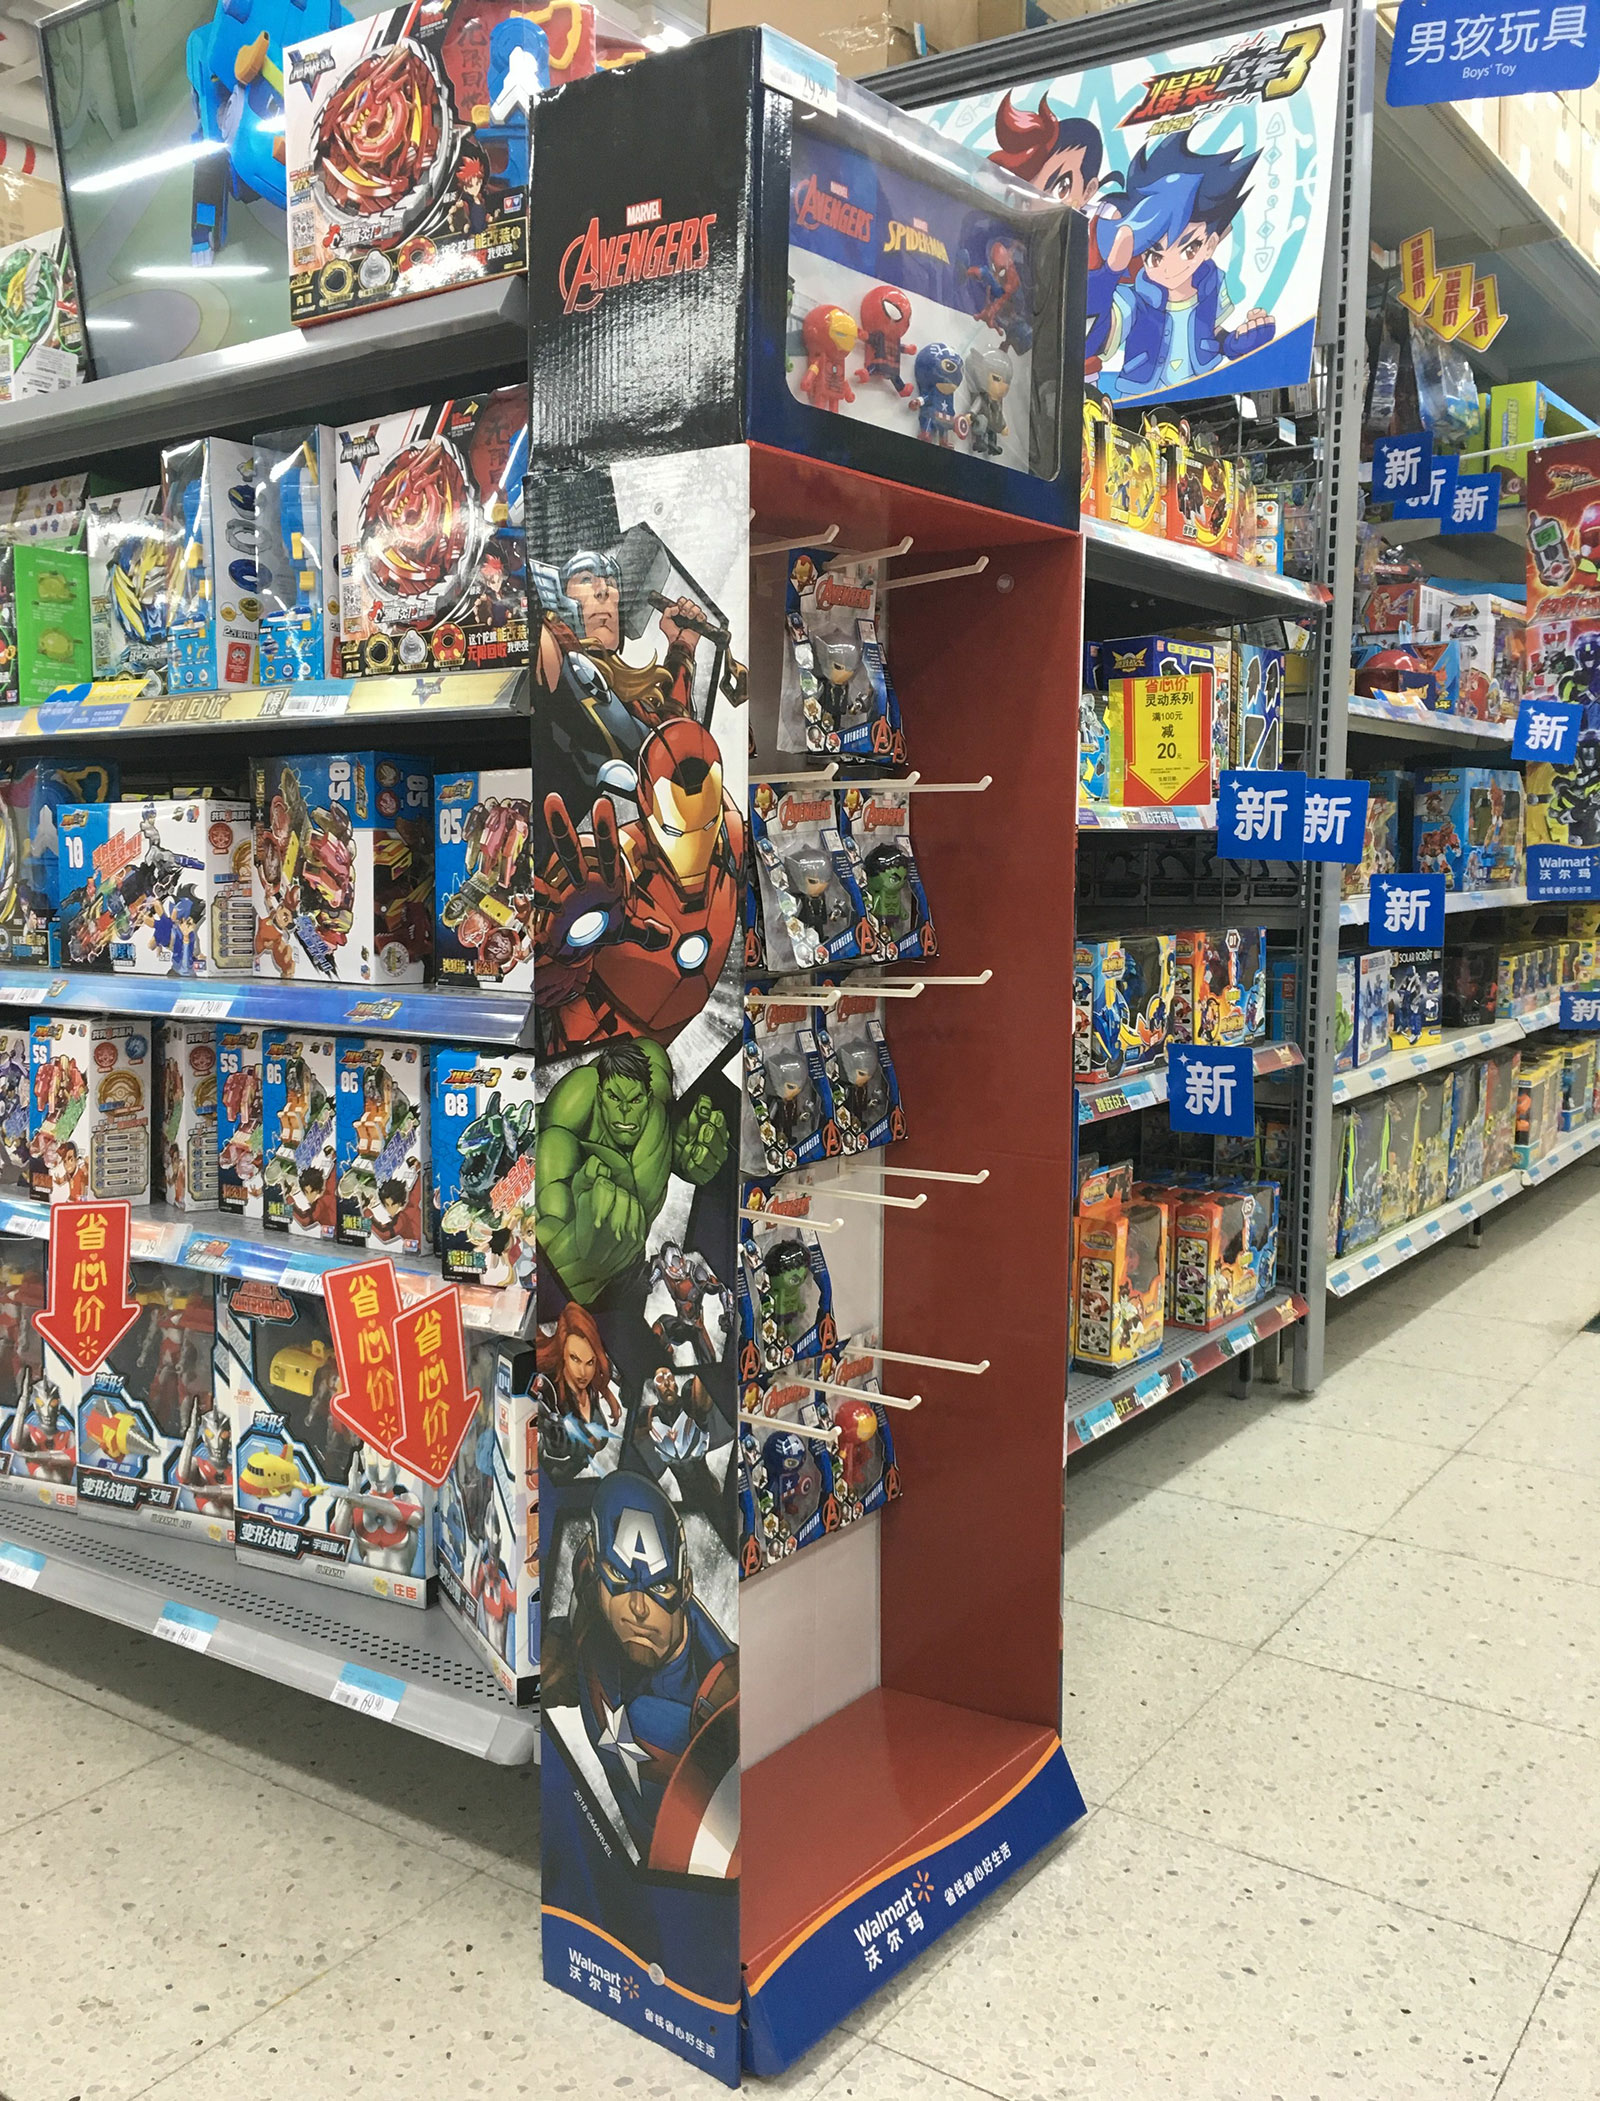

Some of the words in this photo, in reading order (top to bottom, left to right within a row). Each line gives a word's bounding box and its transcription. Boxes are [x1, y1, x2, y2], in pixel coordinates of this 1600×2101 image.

[1405, 6, 1587, 66] 男孩玩具
[1463, 65, 1493, 80] Boys'
[1496, 63, 1517, 76] Toy
[626, 199, 662, 226] MARVEL
[794, 174, 874, 242] AVENGERS
[884, 220, 950, 265] SPIDER-MAN
[559, 213, 717, 315] AVENGERS
[1384, 446, 1421, 489] 新
[1452, 486, 1489, 522] 新
[816, 575, 874, 611] AVENGERS
[1145, 676, 1188, 693] 省心价
[1145, 691, 1194, 707] 灵动系列
[142, 693, 230, 723] 无限回收
[1152, 711, 1183, 722] 满100元
[1161, 725, 1175, 738] 减
[1525, 713, 1569, 751] 新
[329, 762, 351, 801] 05
[439, 809, 462, 844] 05
[779, 795, 832, 831] AVENGERS
[863, 799, 906, 832] AVENGERS
[1235, 787, 1287, 841] 新
[1304, 794, 1351, 844] 新
[1539, 856, 1591, 868] Walmart
[1540, 869, 1591, 880] 沃尔玛
[1384, 888, 1431, 932] 新
[1399, 951, 1415, 963] SOLAR
[1416, 949, 1433, 962] ROBOT
[266, 1063, 282, 1084] 06
[340, 1071, 358, 1093] 06
[1185, 1061, 1237, 1116] 新
[444, 1093, 468, 1117] 08
[73, 1213, 108, 1333] 省心价
[349, 1274, 394, 1412] 省心价
[96, 1373, 125, 1393] 变形
[414, 1309, 449, 1447] 省心价
[253, 1411, 284, 1432] 变形
[56, 1492, 76, 1507] 庄臣
[80, 1477, 137, 1504] 变形战舰
[148, 1488, 171, 1504] 艾斯
[241, 1522, 299, 1553] 变形战舰
[312, 1537, 346, 1556] 宇宙超人
[315, 1564, 346, 1579] ULTRAMAN
[394, 1583, 417, 1600] 庄臣
[573, 1789, 588, 1813] 2018
[944, 1841, 1012, 1906] 省钱省心好生活
[854, 1888, 917, 1947] Walmart
[864, 1909, 926, 1973] 沃尔玛
[568, 1947, 622, 1989] Walmart
[569, 1964, 622, 2005] 沃尔玛
[644, 2007, 716, 2060] 省钱省心好生活
